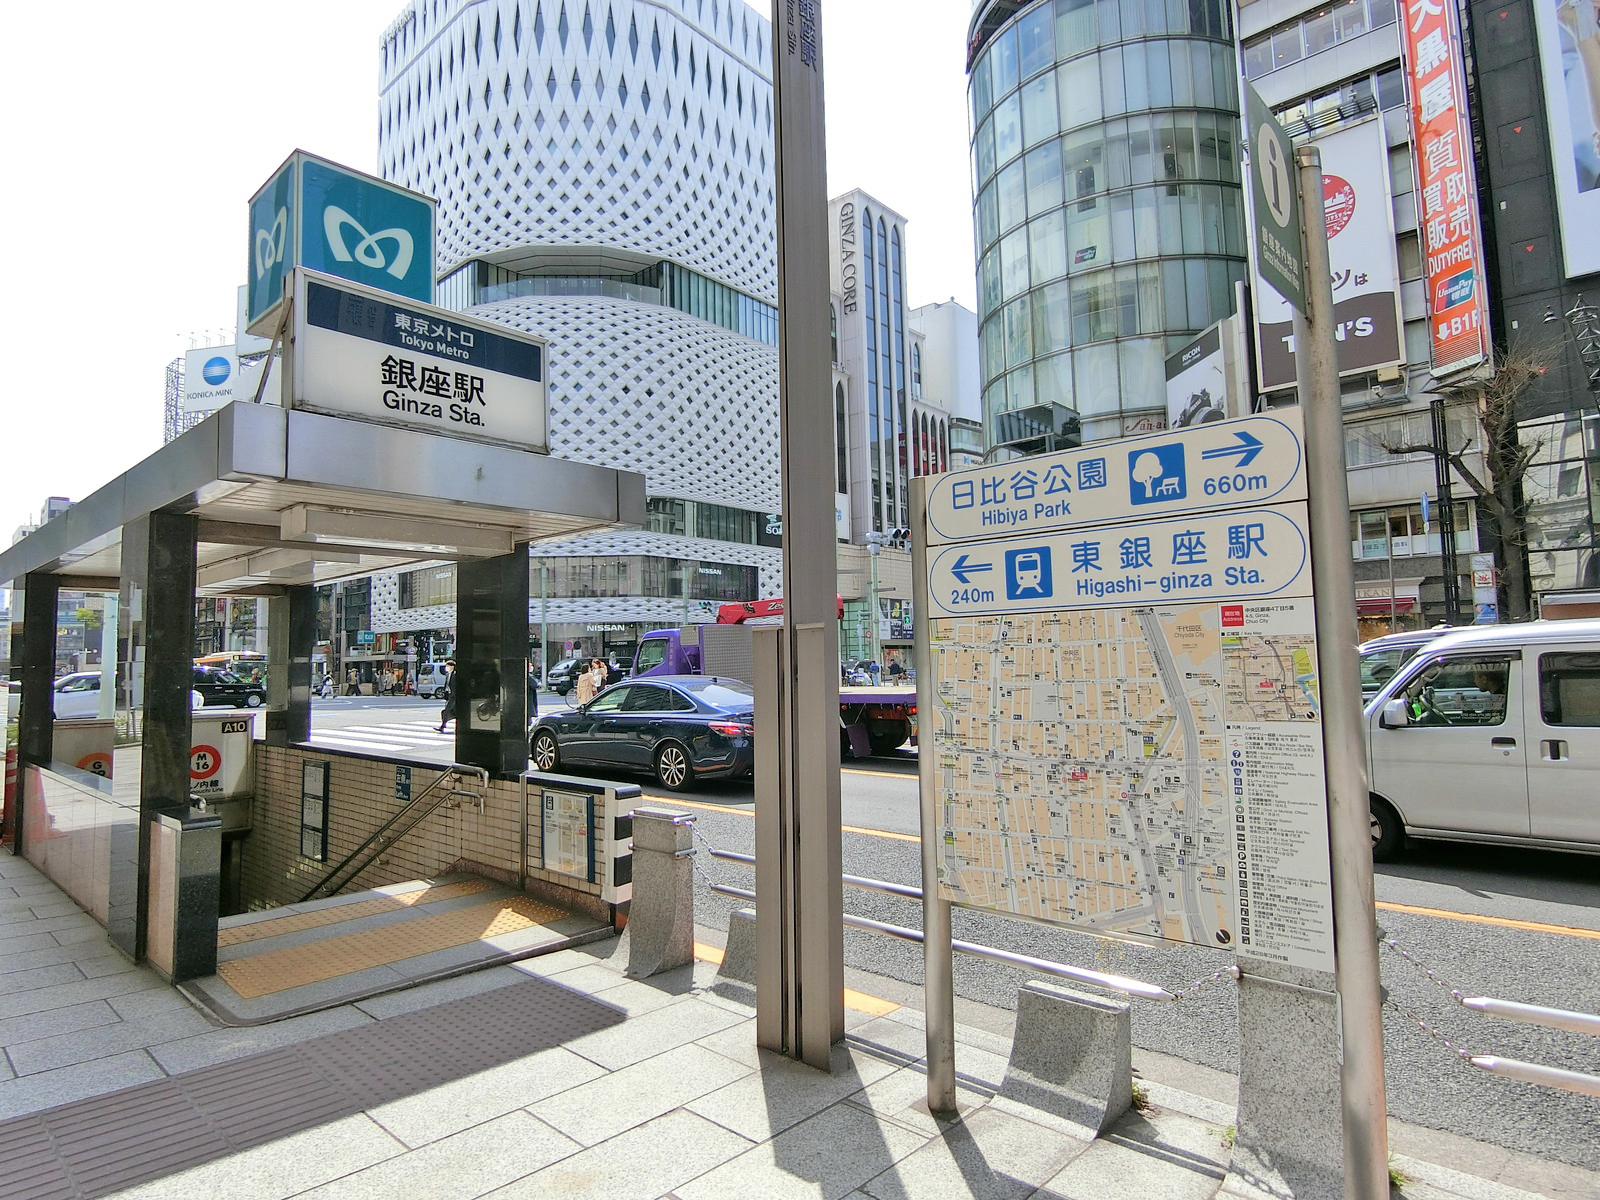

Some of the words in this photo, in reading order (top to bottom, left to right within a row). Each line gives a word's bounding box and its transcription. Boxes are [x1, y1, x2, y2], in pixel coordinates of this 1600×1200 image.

[1425, 129, 1458, 180] 質
[1423, 171, 1467, 219] 買取
[841, 203, 855, 263] GINZA
[1426, 205, 1471, 254] 販売
[843, 264, 857, 315] CORE
[1438, 279, 1473, 297] UnionPay
[393, 311, 474, 348] 東京メトロ
[400, 333, 434, 354] Tokyo
[436, 342, 470, 360] Metro
[1182, 346, 1201, 362] RICOH
[381, 355, 486, 406] 銀座駅
[187, 391, 214, 400] KONICA
[383, 389, 443, 419] Ginza
[449, 404, 486, 427] Sta.
[952, 457, 1107, 510] 日比谷公園
[1203, 472, 1268, 496] 660m
[981, 507, 1028, 527] Hibiya
[1034, 499, 1072, 519] Park
[1071, 523, 1268, 573] 東銀座駅
[1076, 570, 1213, 598] Higashi-ginza
[1225, 566, 1266, 586] Sta.
[951, 587, 995, 606] 240m
[587, 624, 625, 632] NISSAN
[224, 722, 246, 732] A10
[93, 761, 102, 770] G
[195, 762, 209, 770] 16
[197, 753, 207, 761] M
